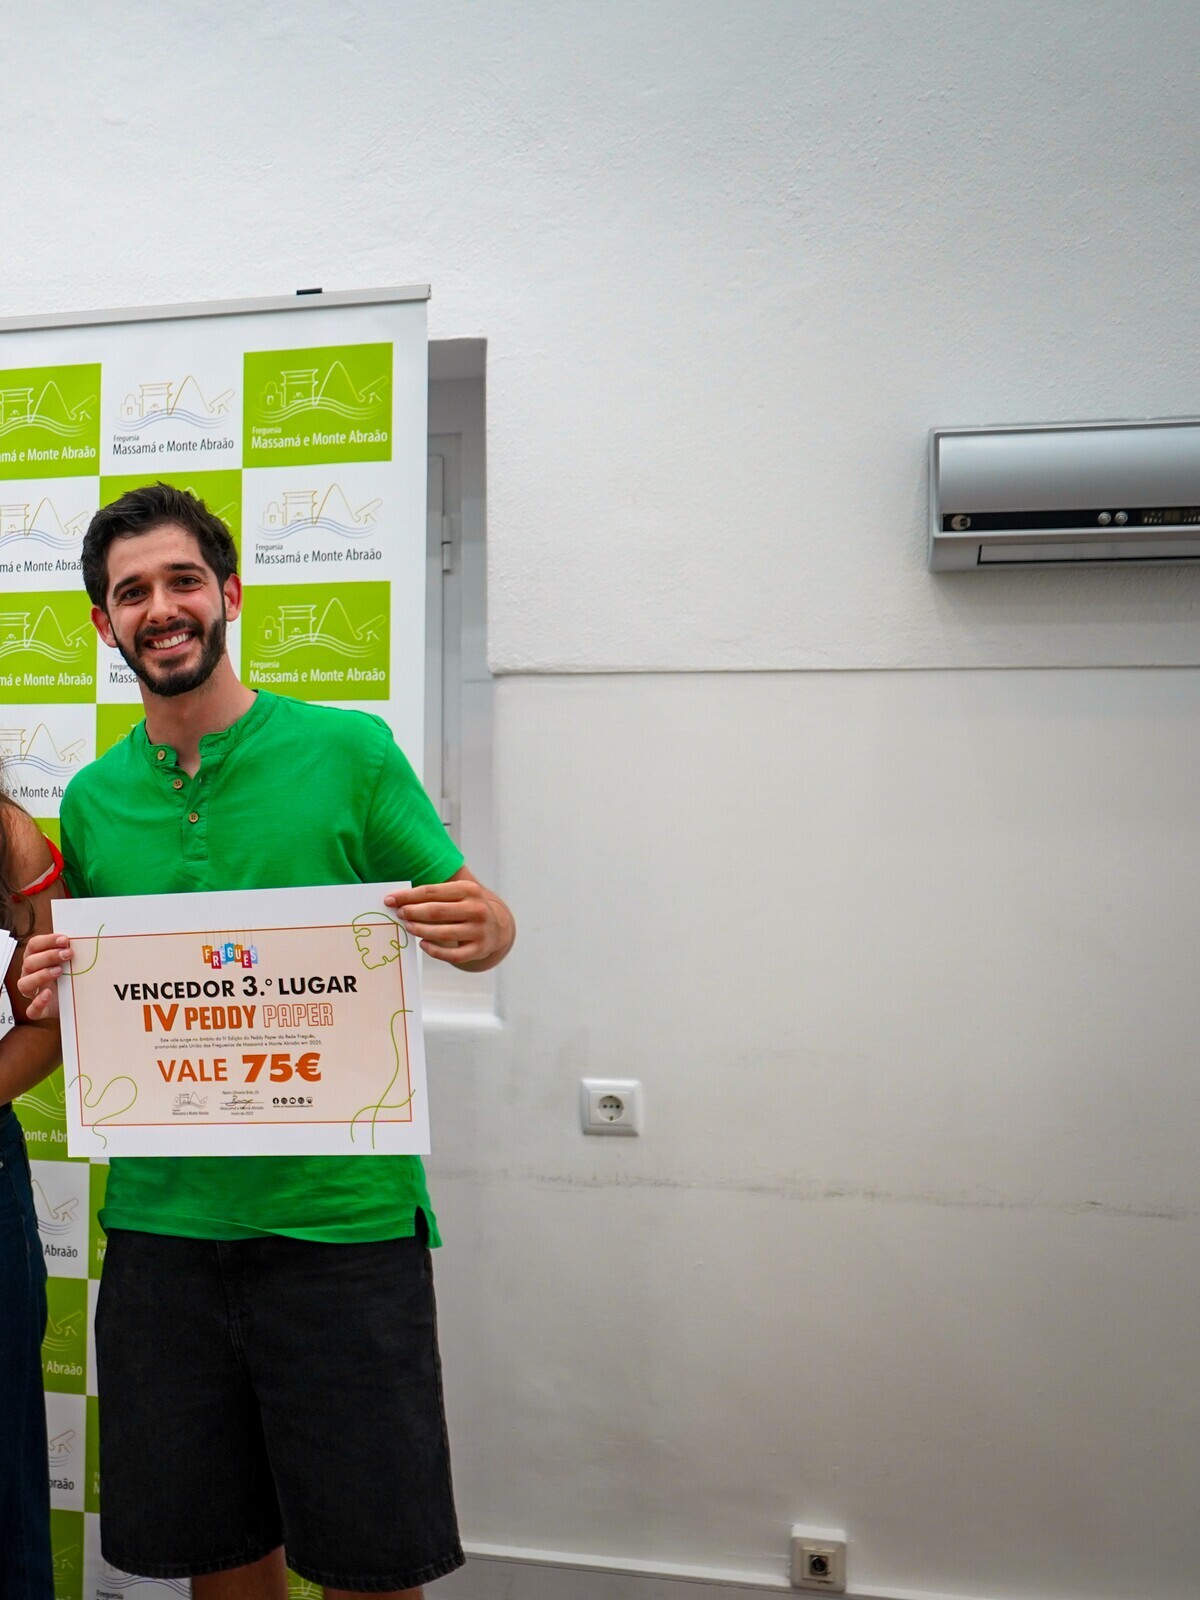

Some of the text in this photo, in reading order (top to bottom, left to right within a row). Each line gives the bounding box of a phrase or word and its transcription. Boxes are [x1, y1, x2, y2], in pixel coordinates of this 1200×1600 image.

[252, 426, 282, 436] Freguesia
[113, 434, 139, 443] Freguesia
[251, 430, 388, 449] Massamá e Monte Abraão
[112, 438, 234, 455] Massamá e Monte Abraão
[19, 453, 25, 462] e
[27, 449, 59, 461] Monte
[61, 446, 96, 460] Abraão
[255, 543, 284, 552] Freguesia
[254, 548, 382, 565] Massamá e Monte Abraão
[16, 563, 22, 572] e
[23, 560, 54, 572] Monte
[55, 559, 84, 571] Abraã
[250, 660, 280, 670] Freguesia
[15, 677, 21, 686] e
[23, 673, 55, 686] Monte
[57, 672, 93, 686] Abraão
[109, 672, 138, 684] Massa
[249, 667, 386, 683] Massamá e Monte Abraão
[12, 788, 18, 798] e
[20, 786, 49, 798] Monte
[203, 945, 258, 968] FREGUÊS
[113, 979, 234, 1001] VENCEDOR
[279, 975, 358, 995] LUGAR
[143, 1002, 334, 1032] IV PEDDY PAPER
[157, 1051, 322, 1083] VALE 75€
[25, 1130, 48, 1142] onte
[44, 1244, 78, 1258] Abraão
[46, 1360, 83, 1376] Abraão
[49, 1478, 75, 1490] raão
